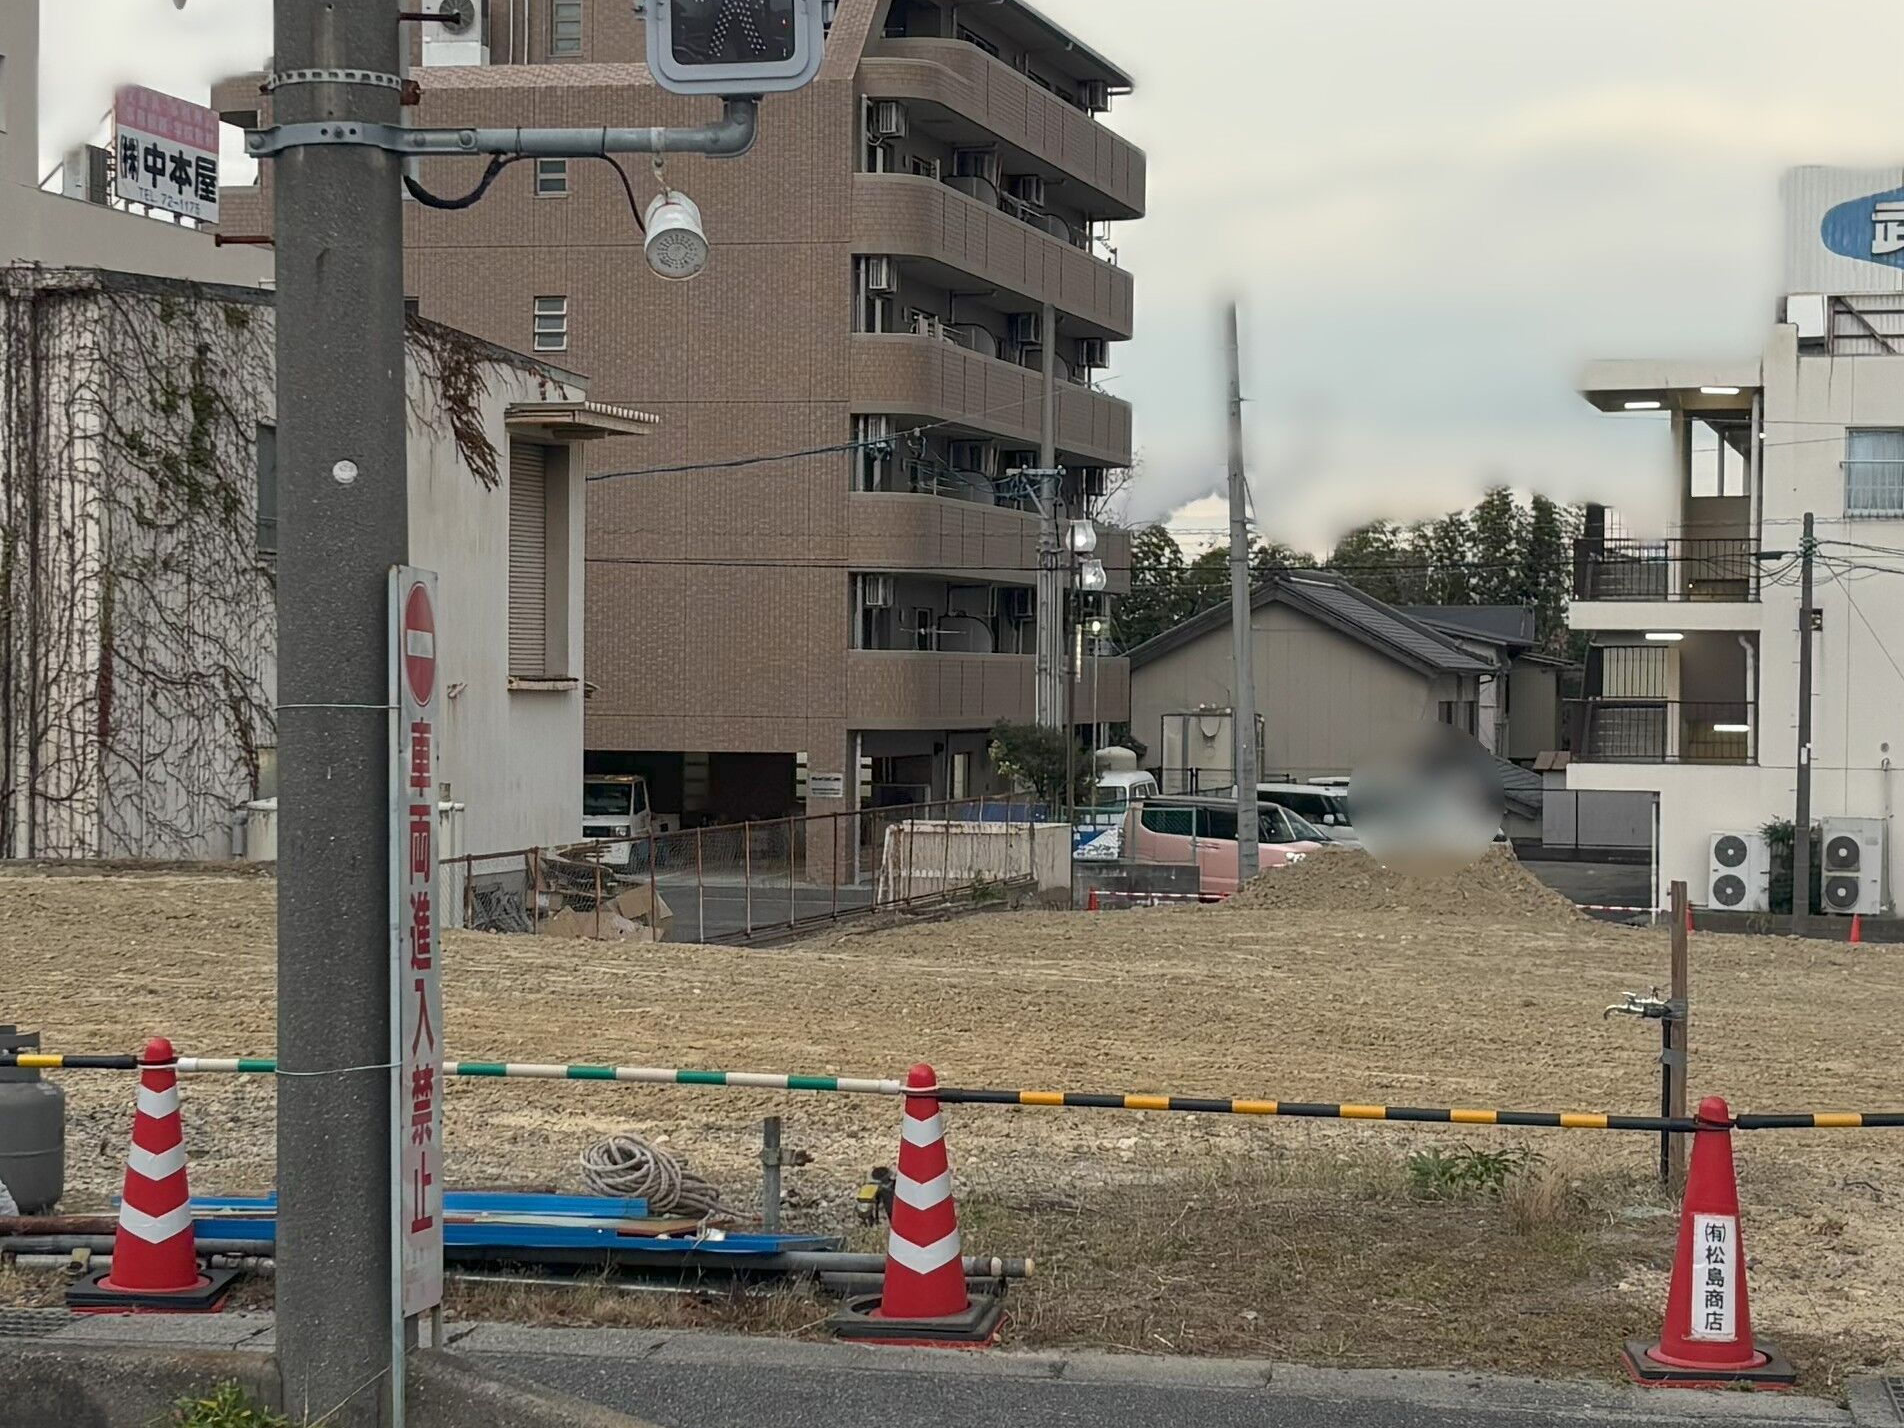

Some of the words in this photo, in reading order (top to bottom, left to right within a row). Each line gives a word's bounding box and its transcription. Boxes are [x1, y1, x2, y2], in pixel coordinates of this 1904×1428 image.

[409, 716, 435, 1234] 車両進入禁止
[1705, 1222, 1726, 1331] (有)松島商店
